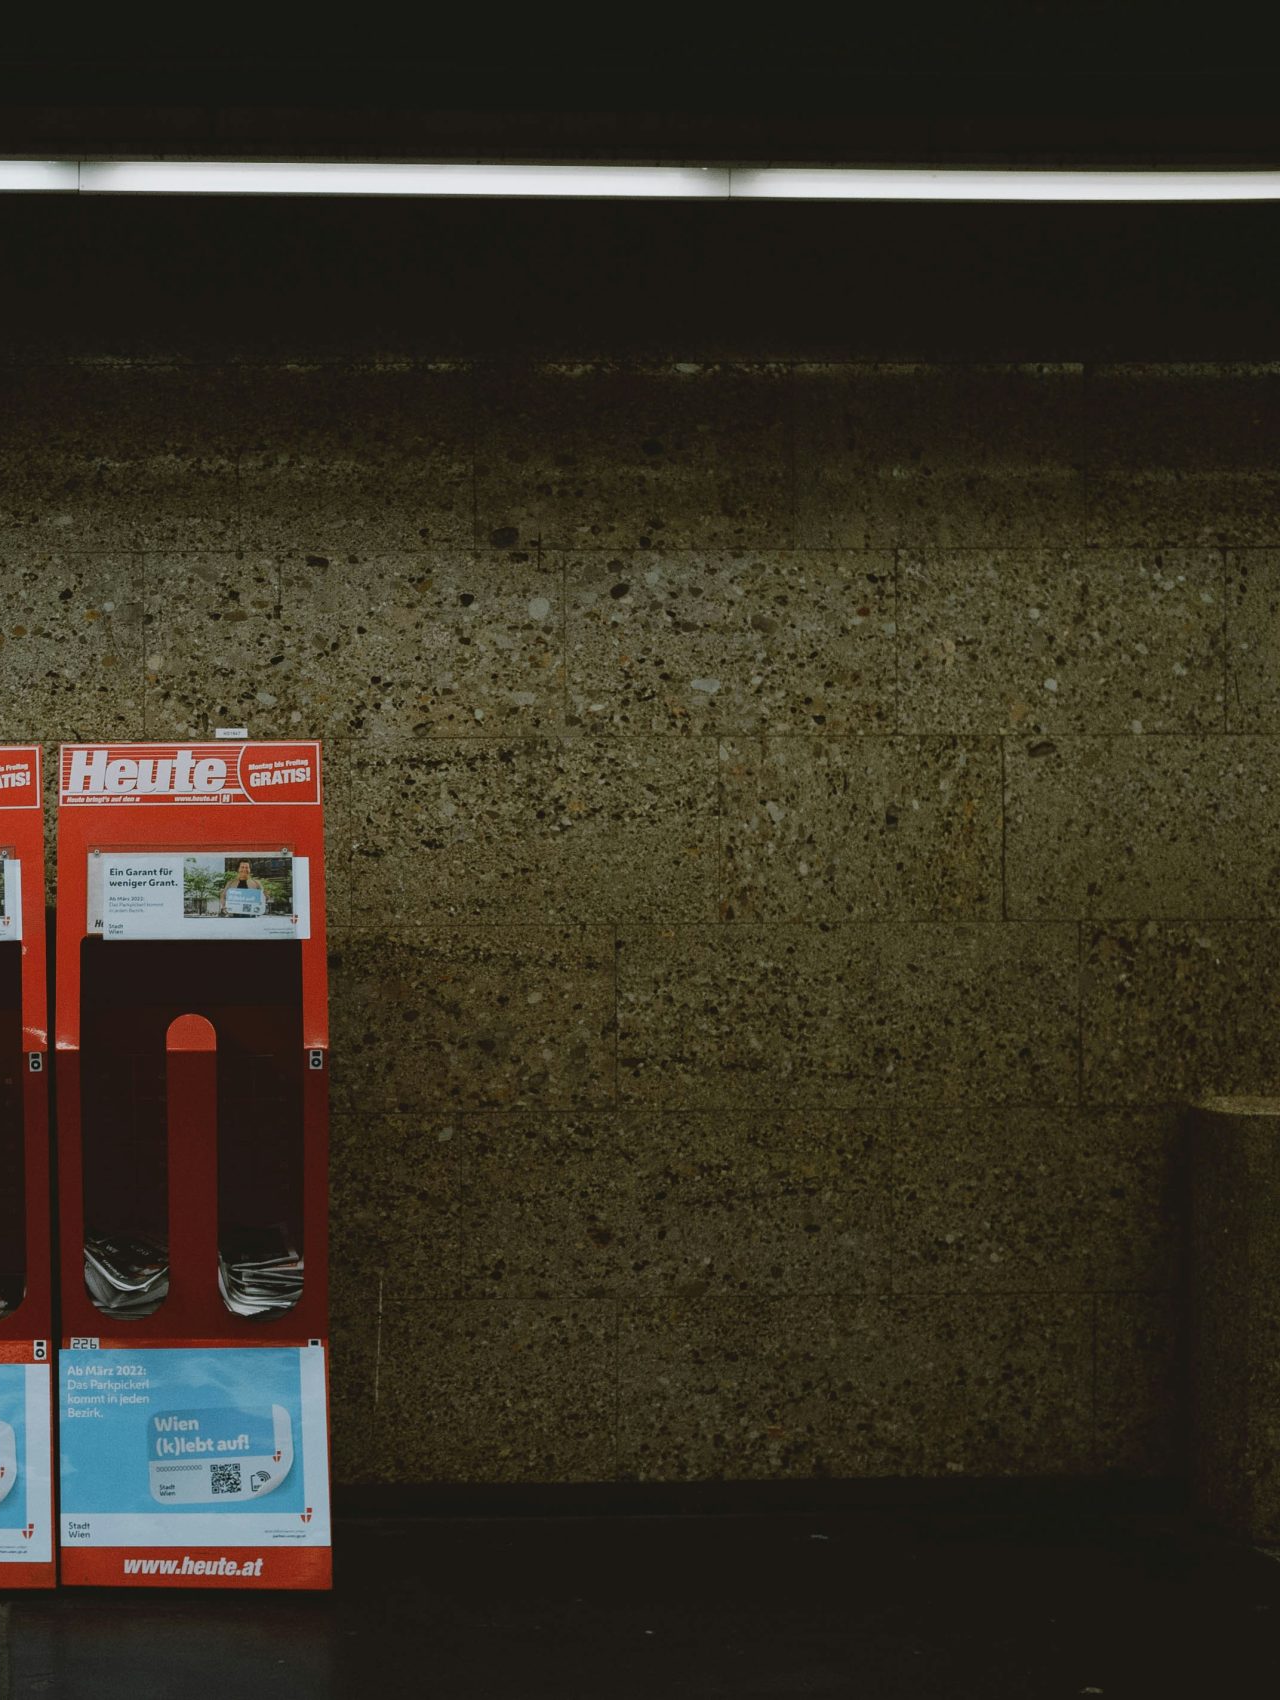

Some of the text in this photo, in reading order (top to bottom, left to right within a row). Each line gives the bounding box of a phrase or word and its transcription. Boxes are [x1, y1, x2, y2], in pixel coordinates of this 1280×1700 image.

[67, 749, 228, 794] Heute
[249, 766, 311, 788] GRATIS!
[109, 867, 173, 876] Ein Garant für
[109, 878, 178, 889] weniger Grant.
[67, 1365, 147, 1376] Ab März 2022:
[67, 1379, 150, 1393] Das Parkpickerl
[67, 1394, 150, 1406] kommt in jeden
[67, 1408, 104, 1418] Bezirk.
[154, 1416, 199, 1432] Wien
[156, 1434, 250, 1456] (k)lebt auf!
[68, 1521, 91, 1530] Stadt
[68, 1530, 91, 1539] Wien
[123, 1556, 264, 1577] www.heute.at
